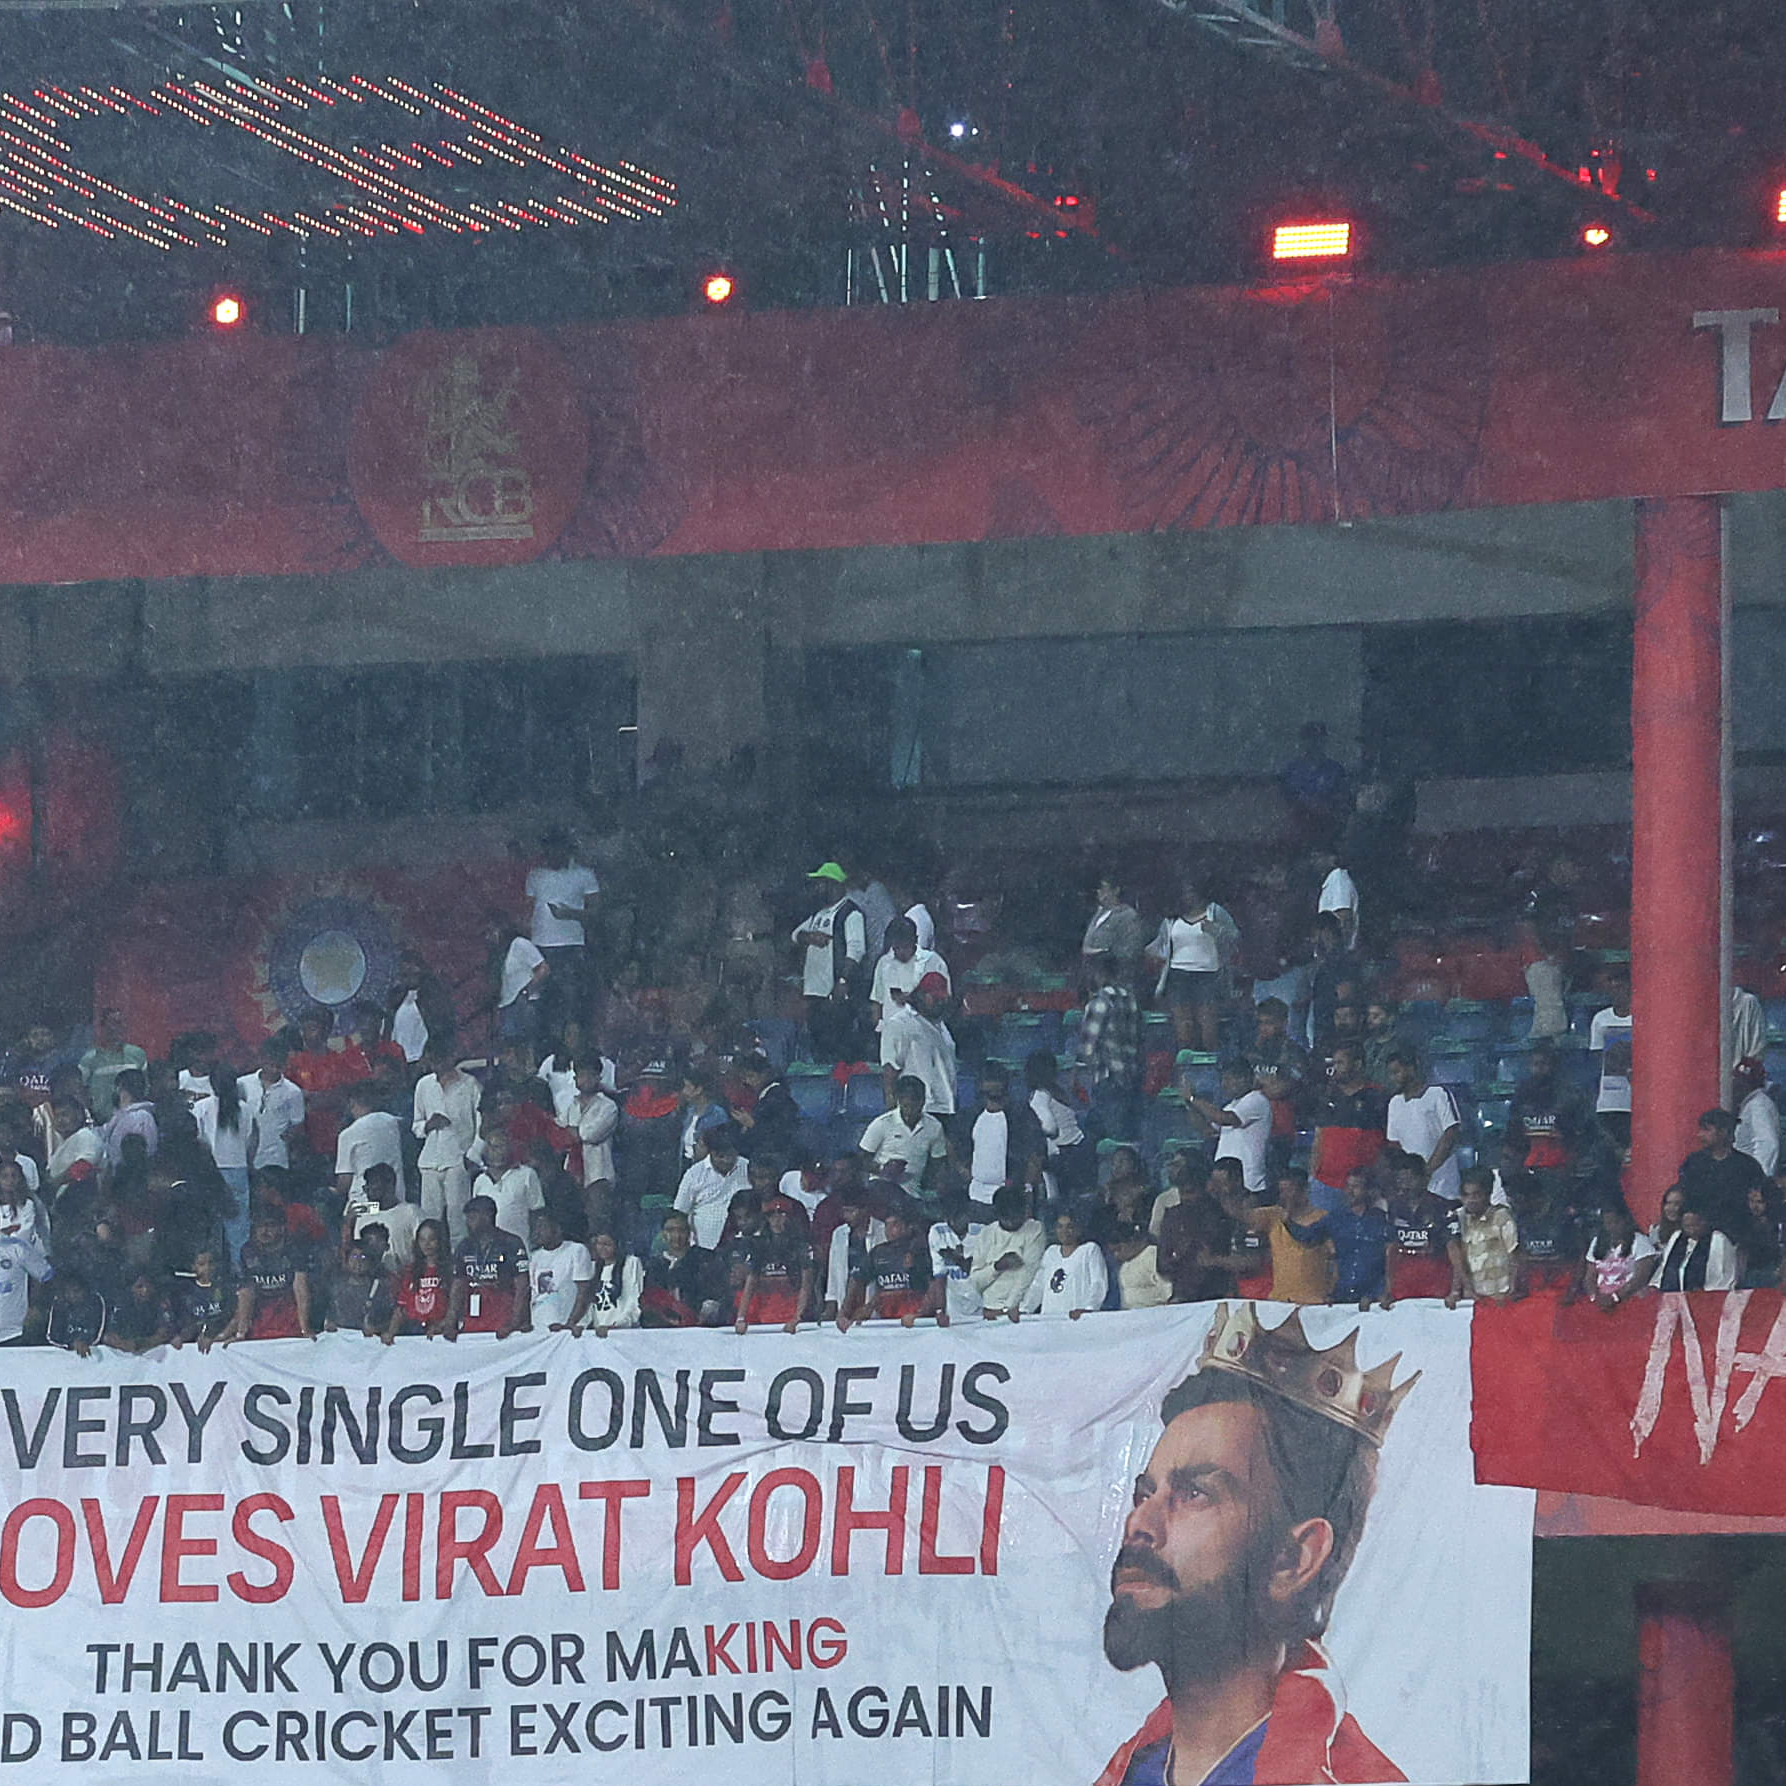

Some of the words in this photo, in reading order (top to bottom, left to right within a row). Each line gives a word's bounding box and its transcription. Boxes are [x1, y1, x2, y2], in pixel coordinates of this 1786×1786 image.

[241, 1372, 546, 1466] SINGLE
[567, 1367, 745, 1452] ONE
[764, 1366, 879, 1442] OF
[895, 1361, 1011, 1446] US
[321, 1479, 650, 1603] VIRAT
[674, 1464, 1005, 1586] KOHLI
[86, 1642, 302, 1694] THANK
[318, 1639, 447, 1694] YOU
[468, 1633, 585, 1691] FOR
[605, 1617, 847, 1681] MAKING
[60, 1710, 204, 1761] BALL
[222, 1707, 491, 1762] CRICKET
[512, 1691, 791, 1755] EXCITING
[812, 1685, 993, 1739] AGAIN
